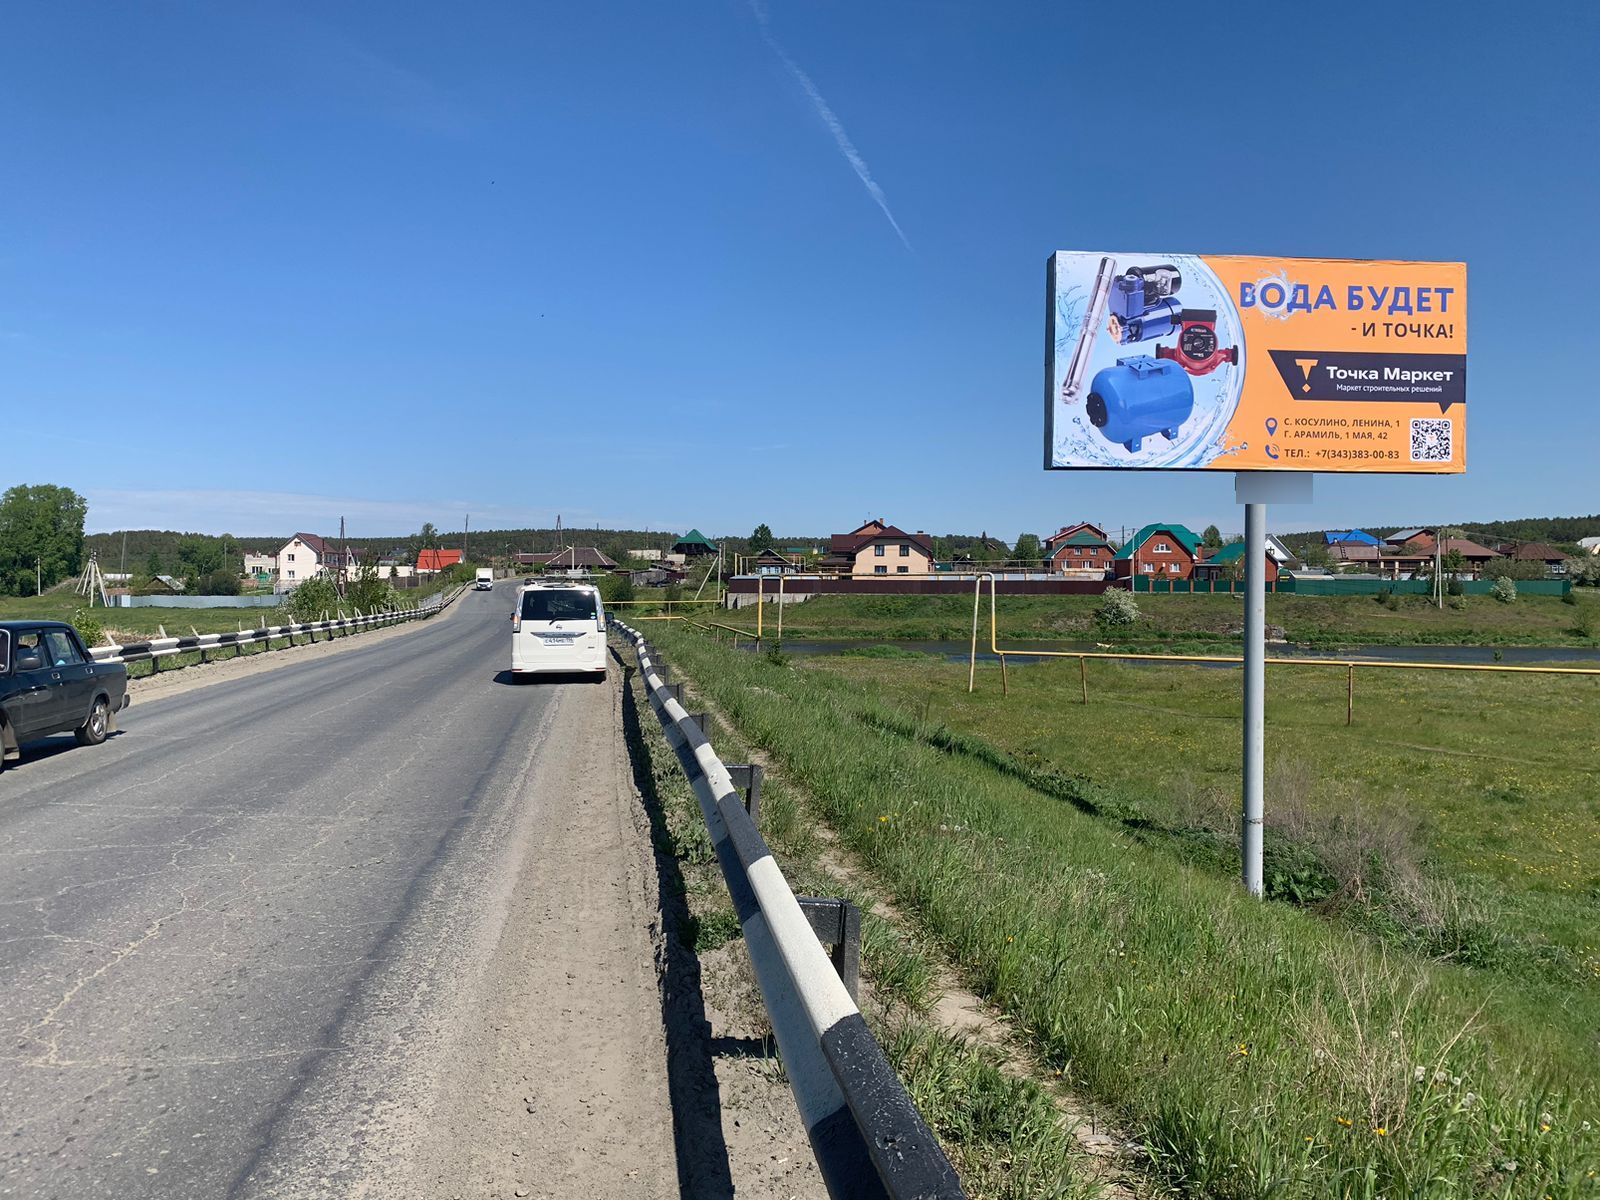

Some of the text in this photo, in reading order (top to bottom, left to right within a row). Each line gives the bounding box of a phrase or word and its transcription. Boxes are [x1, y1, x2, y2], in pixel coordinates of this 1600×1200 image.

[1240, 281, 1454, 316] ВОДА БУДЕТ
[1362, 322, 1376, 337] И
[1383, 322, 1454, 339] ТОЧКА!
[1326, 366, 1453, 384] Точка Маркет
[1336, 384, 1362, 392] Маркет
[1363, 385, 1410, 393] строительных
[1284, 418, 1293, 426] С.
[1295, 418, 1350, 428] КОСУЛИНО,
[1352, 419, 1393, 429] ЛЕНИНА,
[1294, 431, 1343, 440] АРАМИЛЬ,
[1352, 432, 1375, 440] МАЯ,
[1377, 432, 1388, 440] 42
[1284, 449, 1400, 460] ТЕЛ.: +7(343)383-00-83
